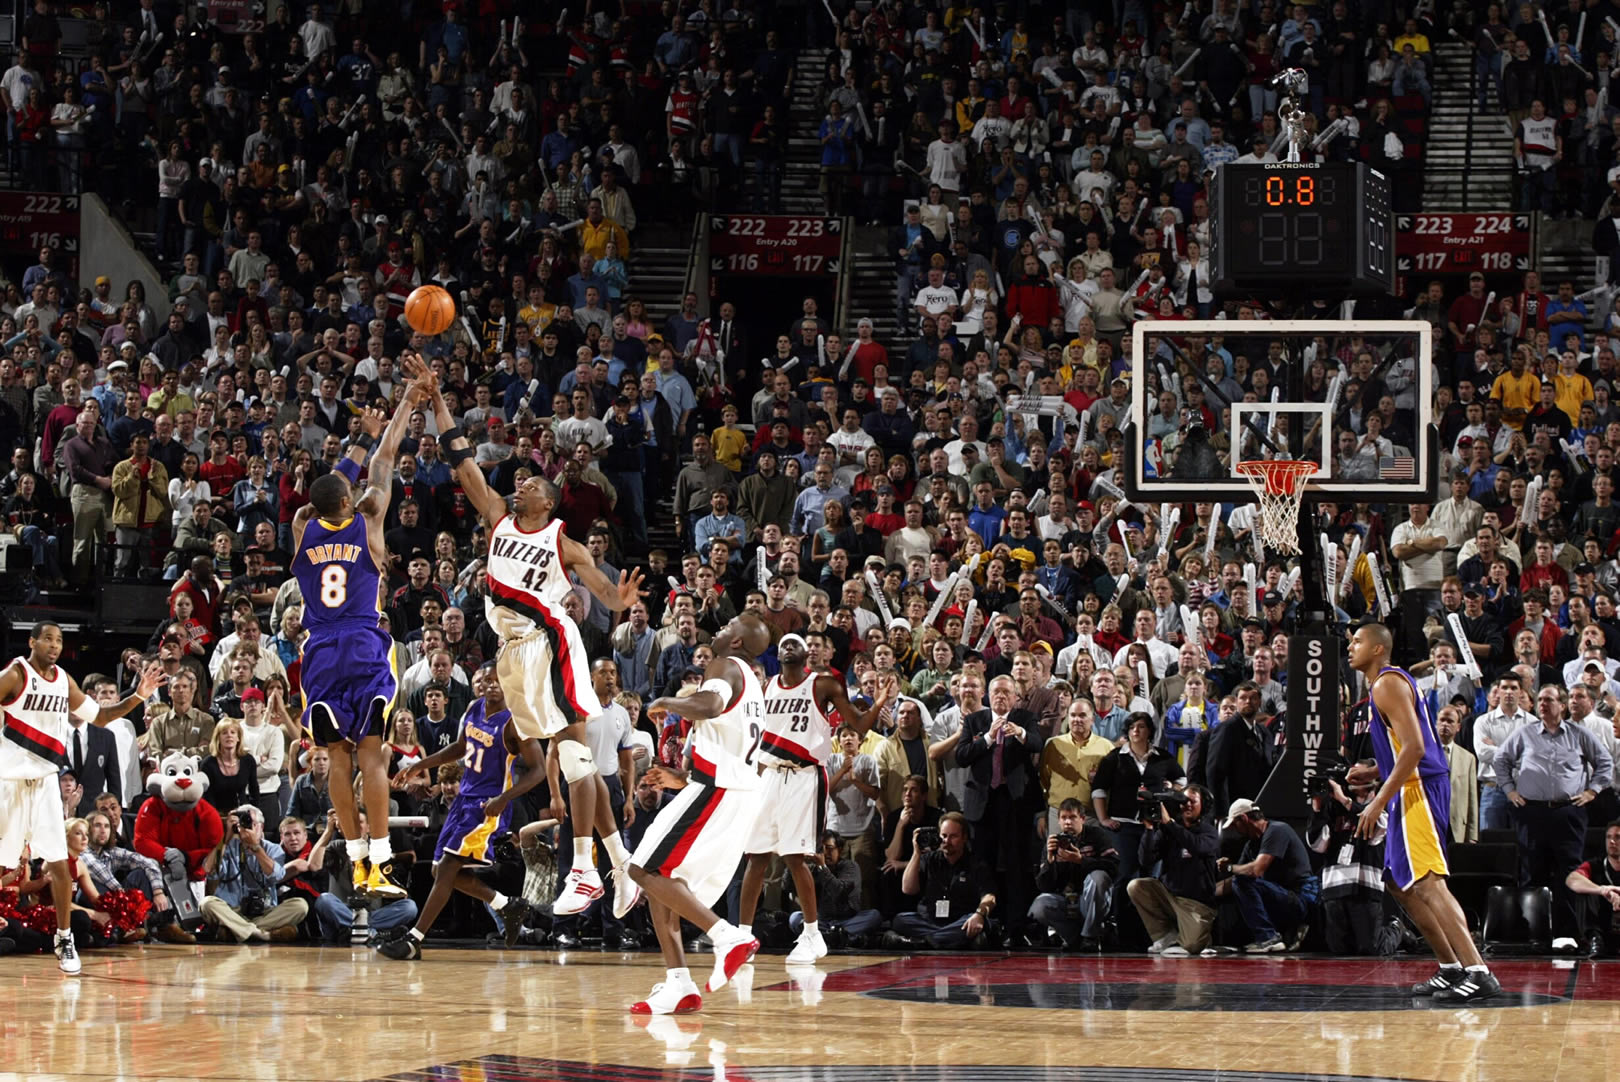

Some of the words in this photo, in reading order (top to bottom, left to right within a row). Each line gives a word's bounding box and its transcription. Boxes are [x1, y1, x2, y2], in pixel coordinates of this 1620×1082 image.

[1265, 176, 1316, 207] 0.8
[23, 195, 62, 214] 222
[728, 219, 767, 237] 222
[787, 220, 824, 238] 223
[1415, 217, 1454, 235] 223
[1473, 217, 1512, 235] 224
[30, 231, 61, 250] 116
[756, 238, 779, 247] Entry
[780, 238, 798, 246] A20
[1443, 236, 1466, 246] Entry
[1467, 236, 1484, 245] A21
[728, 253, 759, 271] 116
[793, 254, 824, 272] 117
[1415, 252, 1447, 270] 117
[1481, 252, 1513, 270] 118
[305, 543, 363, 566] BRYANT
[492, 537, 556, 569] BLAZERS
[320, 562, 348, 609] 8
[521, 568, 549, 592] 42
[32, 677, 38, 691] C
[791, 715, 810, 732] 23
[1302, 639, 1324, 804] SOUTHWES
[464, 742, 485, 774] 21
